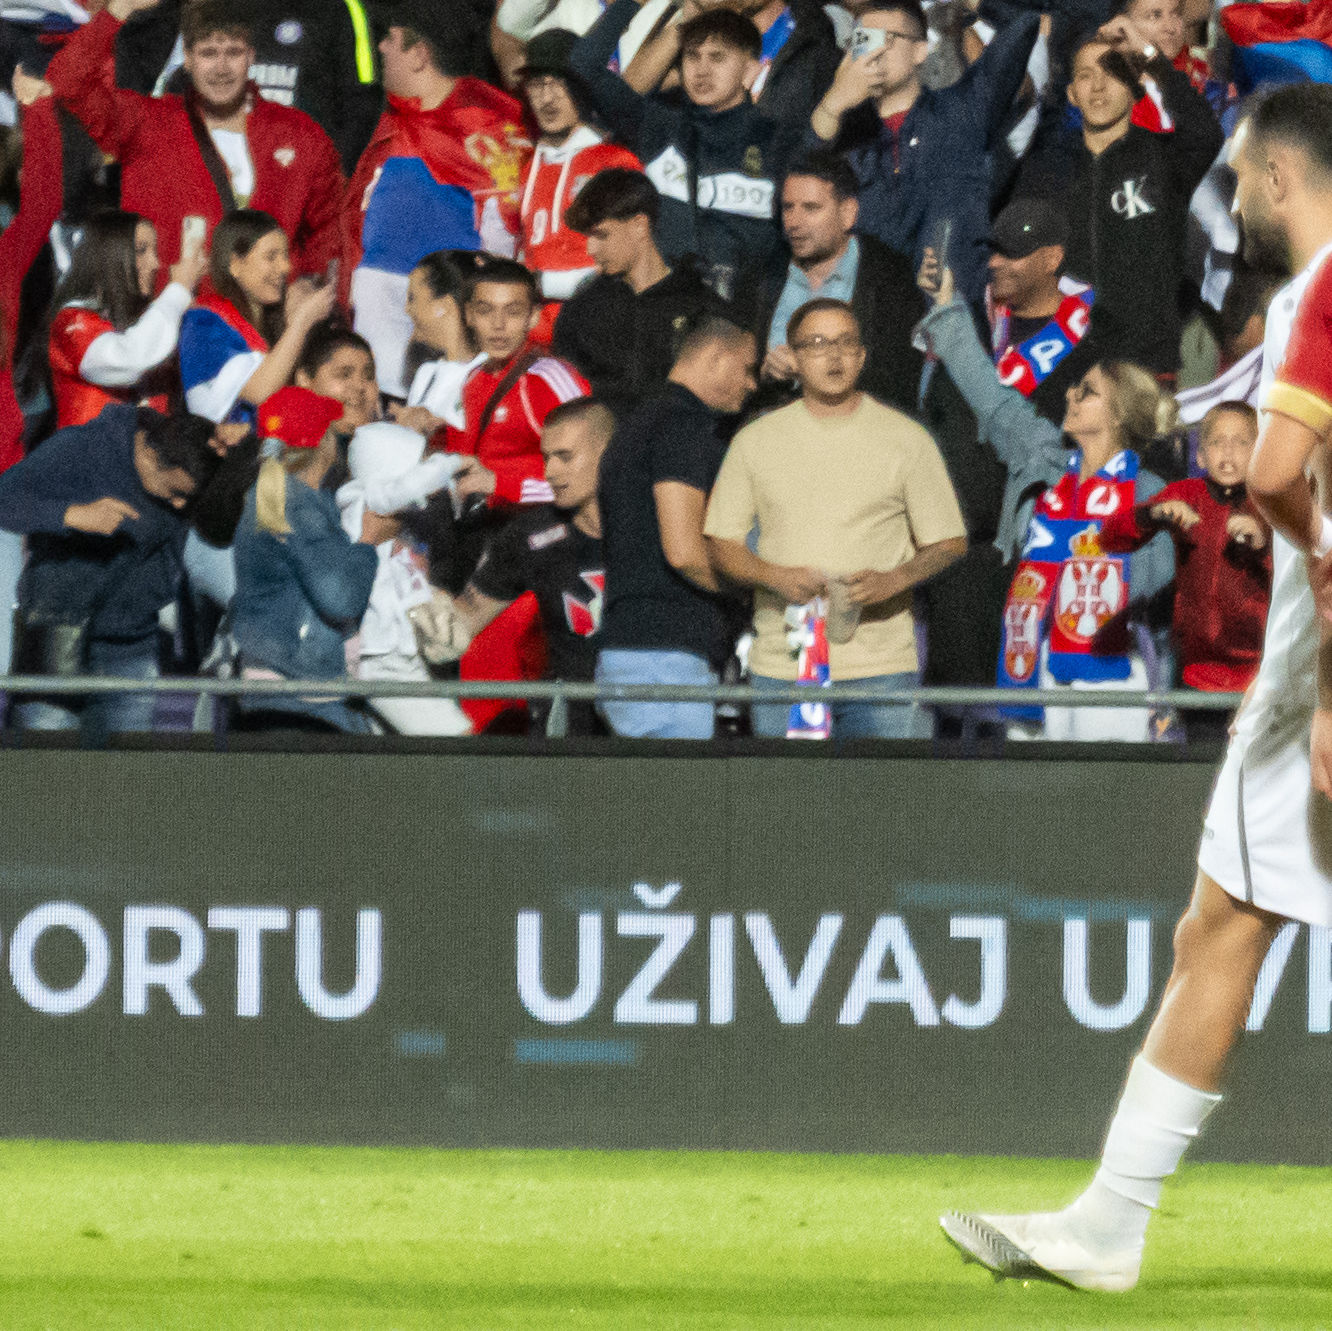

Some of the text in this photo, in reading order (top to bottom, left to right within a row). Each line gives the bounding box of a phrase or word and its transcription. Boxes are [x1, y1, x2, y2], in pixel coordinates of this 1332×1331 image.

[0, 900, 383, 1021] ORTU
[516, 881, 1007, 1029] UŽIVAJ
[1063, 915, 1152, 1029] U
